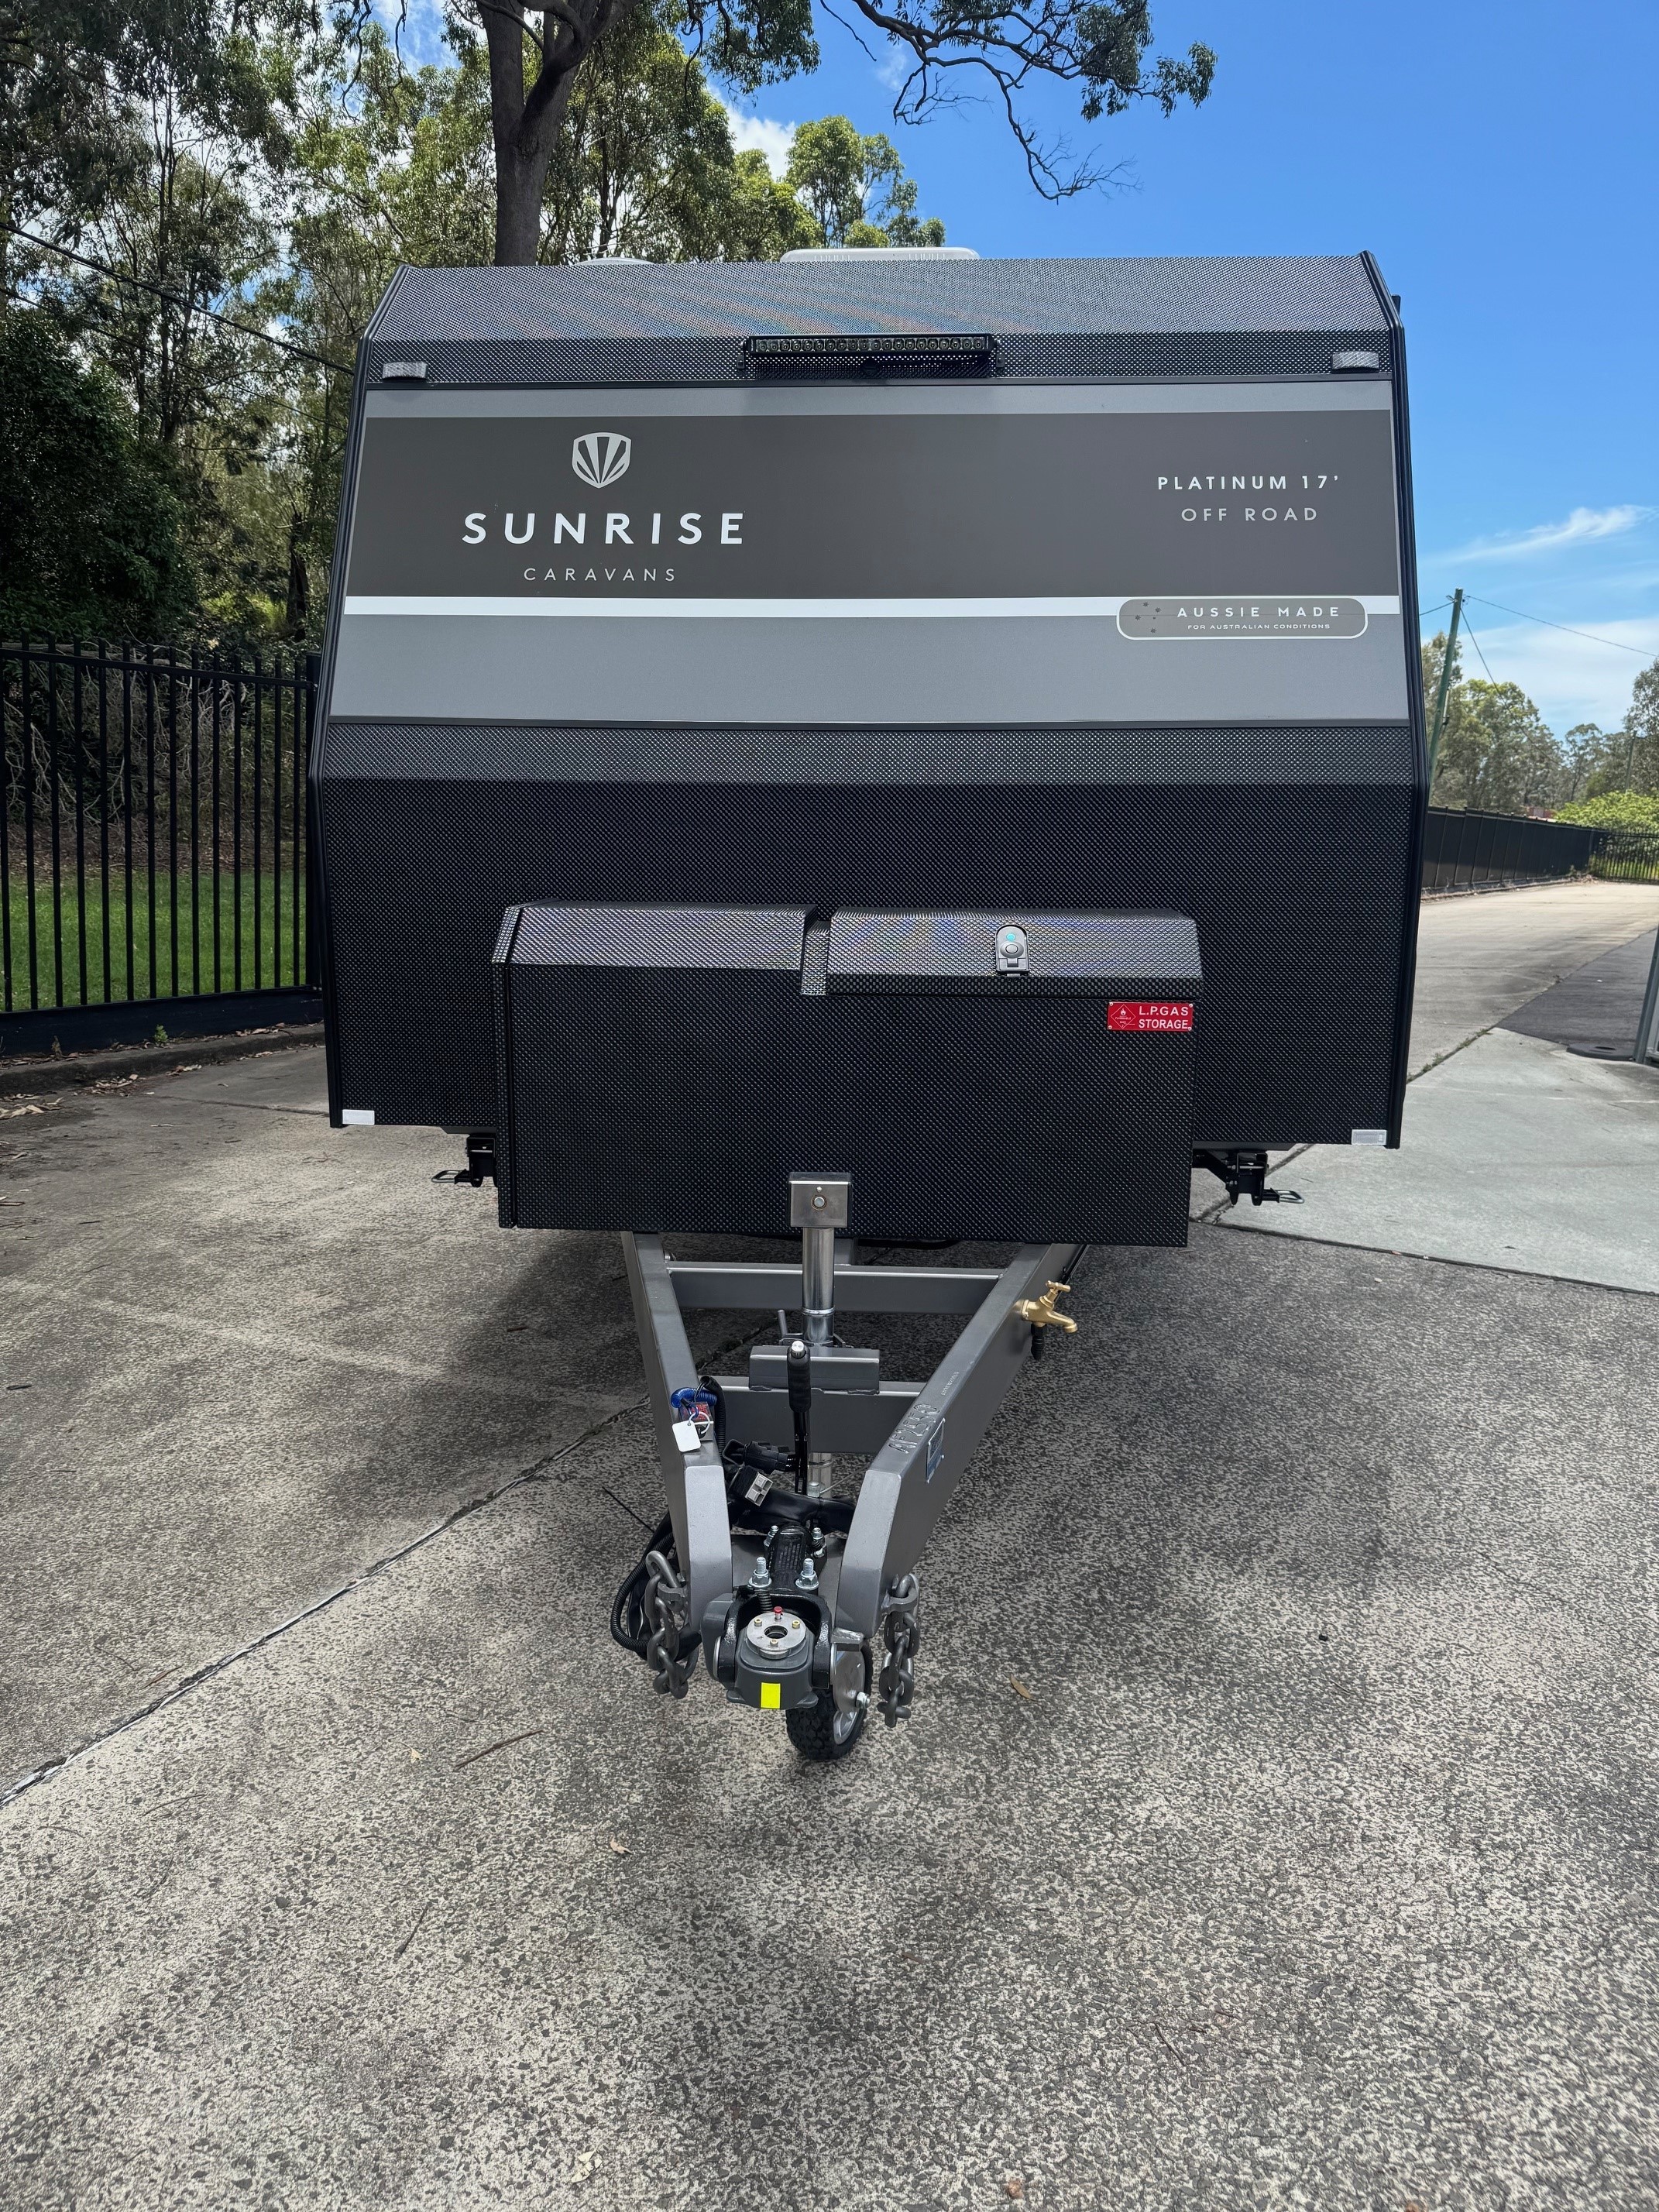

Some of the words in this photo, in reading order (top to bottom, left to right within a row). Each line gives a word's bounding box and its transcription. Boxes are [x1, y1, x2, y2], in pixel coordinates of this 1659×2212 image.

[1158, 476, 1287, 490] PLATINUM
[1301, 475, 1340, 489] 17'
[1181, 508, 1228, 522] OFF
[1245, 507, 1318, 521] ROAD
[462, 512, 744, 544] SUNRISE
[524, 568, 675, 582] CARAVANS
[1176, 607, 1260, 618] AUSSIE
[1278, 606, 1339, 617] MADE
[1139, 1005, 1189, 1016] L.P.GAS
[1139, 1018, 1189, 1029] STORAGE
